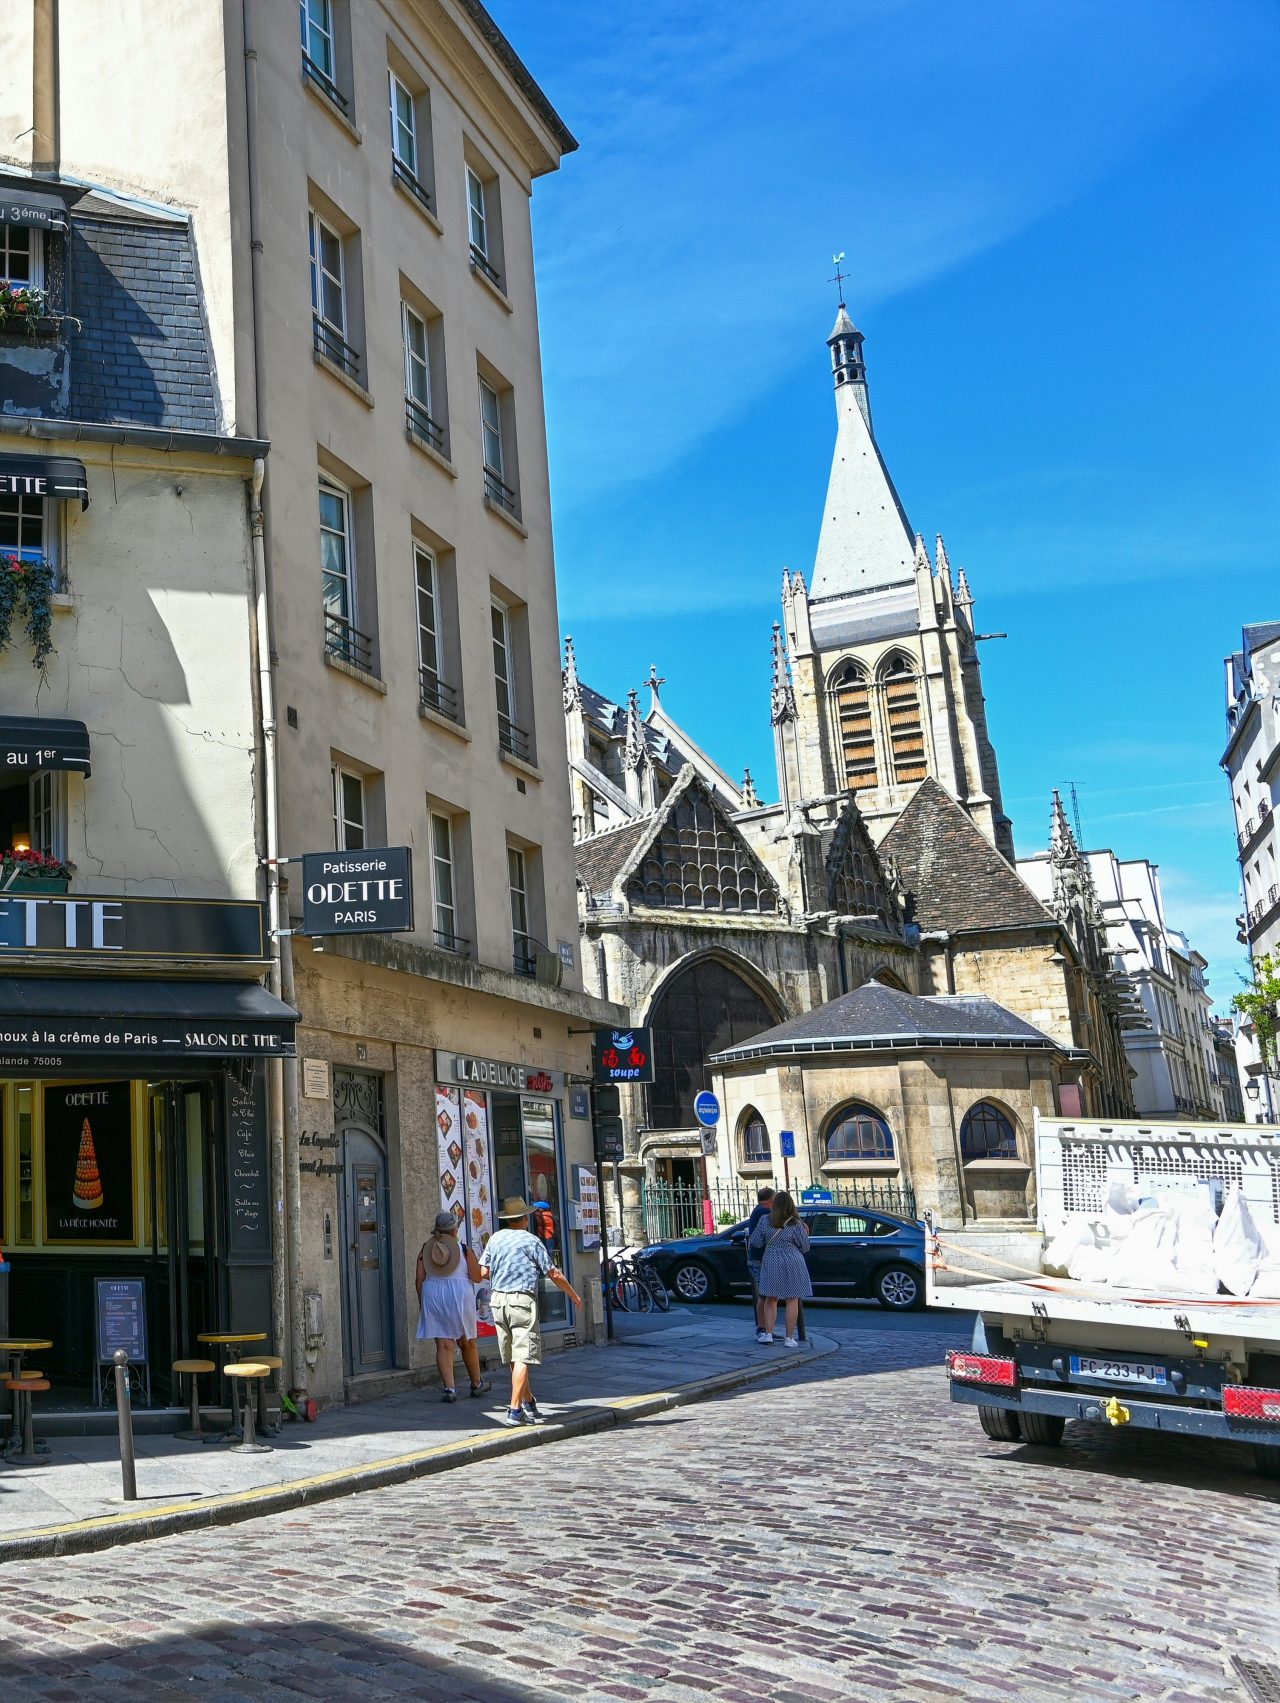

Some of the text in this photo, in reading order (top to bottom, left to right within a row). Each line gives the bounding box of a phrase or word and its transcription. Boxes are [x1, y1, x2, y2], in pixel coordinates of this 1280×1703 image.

[6, 752, 28, 765] au
[35, 748, 57, 766] 1er
[323, 859, 387, 874] Patisserie
[307, 879, 404, 905] ODETTE
[334, 910, 377, 924] PARIS
[31, 1030, 40, 1043] à
[44, 1031, 56, 1043] la
[104, 1032, 120, 1044] de
[124, 1032, 158, 1045] Paris
[184, 1033, 228, 1047] SALON
[231, 1034, 249, 1047] DE
[33, 1057, 62, 1066] 75005
[609, 1068, 640, 1080] soupe
[65, 1091, 109, 1107] ODETTE
[236, 1128, 253, 1142] Café
[234, 1169, 260, 1178] Chocolat
[1080, 1359, 1155, 1380] FC-233-PJ
